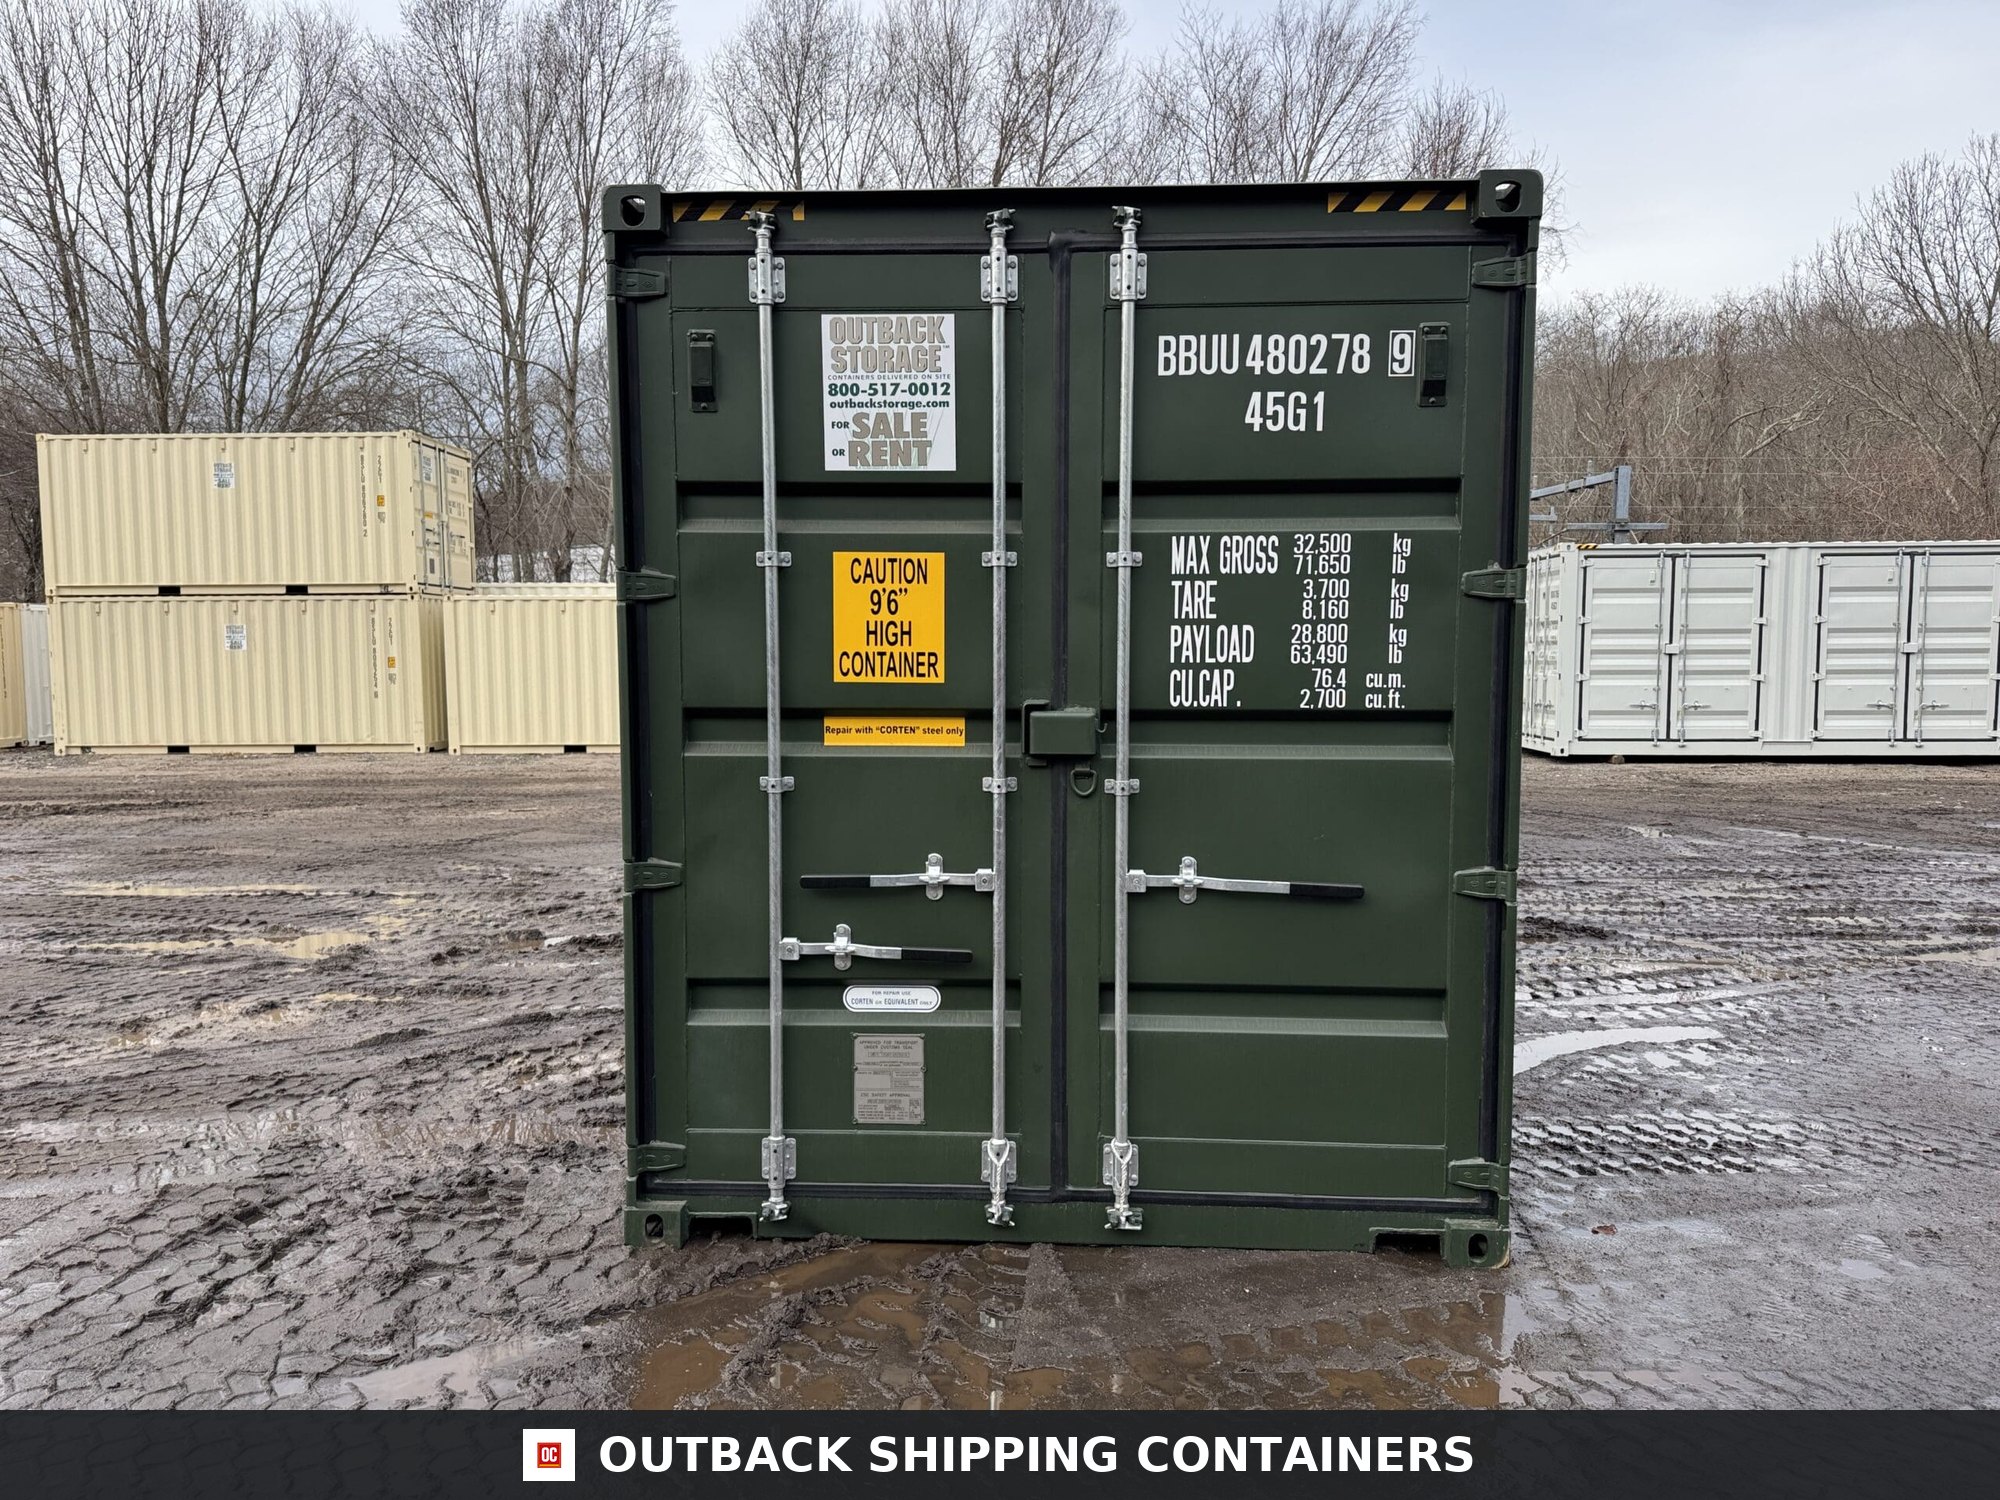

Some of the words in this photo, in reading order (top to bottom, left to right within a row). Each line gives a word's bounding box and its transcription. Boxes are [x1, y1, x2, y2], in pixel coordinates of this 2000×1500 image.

[829, 316, 946, 345] OUTBACK
[830, 345, 942, 373] STORAGE
[1392, 333, 1412, 374] 9
[828, 382, 951, 397] 800-517-0012
[829, 398, 950, 411] outbackstorage.com
[1244, 390, 1325, 432] 45G1
[831, 421, 850, 429] FOR
[852, 411, 928, 440] SALE
[831, 448, 846, 457] OR
[848, 440, 933, 467] RENT
[1171, 535, 1211, 575] MAX
[1219, 535, 1279, 574] GROSS
[1293, 533, 1351, 554] 32,500
[1393, 532, 1412, 557] kg
[850, 557, 928, 585] CAUTION
[1293, 554, 1351, 575] 71,650
[1392, 554, 1406, 574] lb
[1171, 580, 1218, 619] TARE
[1302, 578, 1350, 600] 3,700
[1391, 578, 1410, 602] kg
[1302, 599, 1349, 620] 8,160
[1390, 599, 1404, 619] lb
[866, 620, 912, 647] HIGH
[1169, 624, 1255, 664] PAYLOAD
[1291, 623, 1348, 645] 28,800
[1389, 623, 1407, 647] kg
[839, 651, 939, 678] CONTAINER
[1290, 644, 1348, 665] 63,490
[1388, 644, 1402, 664] lb
[1311, 668, 1346, 688] 76.4
[1365, 672, 1406, 688] cu.m.
[1300, 688, 1346, 709] 2,700
[1365, 691, 1405, 709] cu.ft.
[825, 726, 852, 735] Repair
[855, 726, 873, 734] with
[946, 727, 964, 736] only
